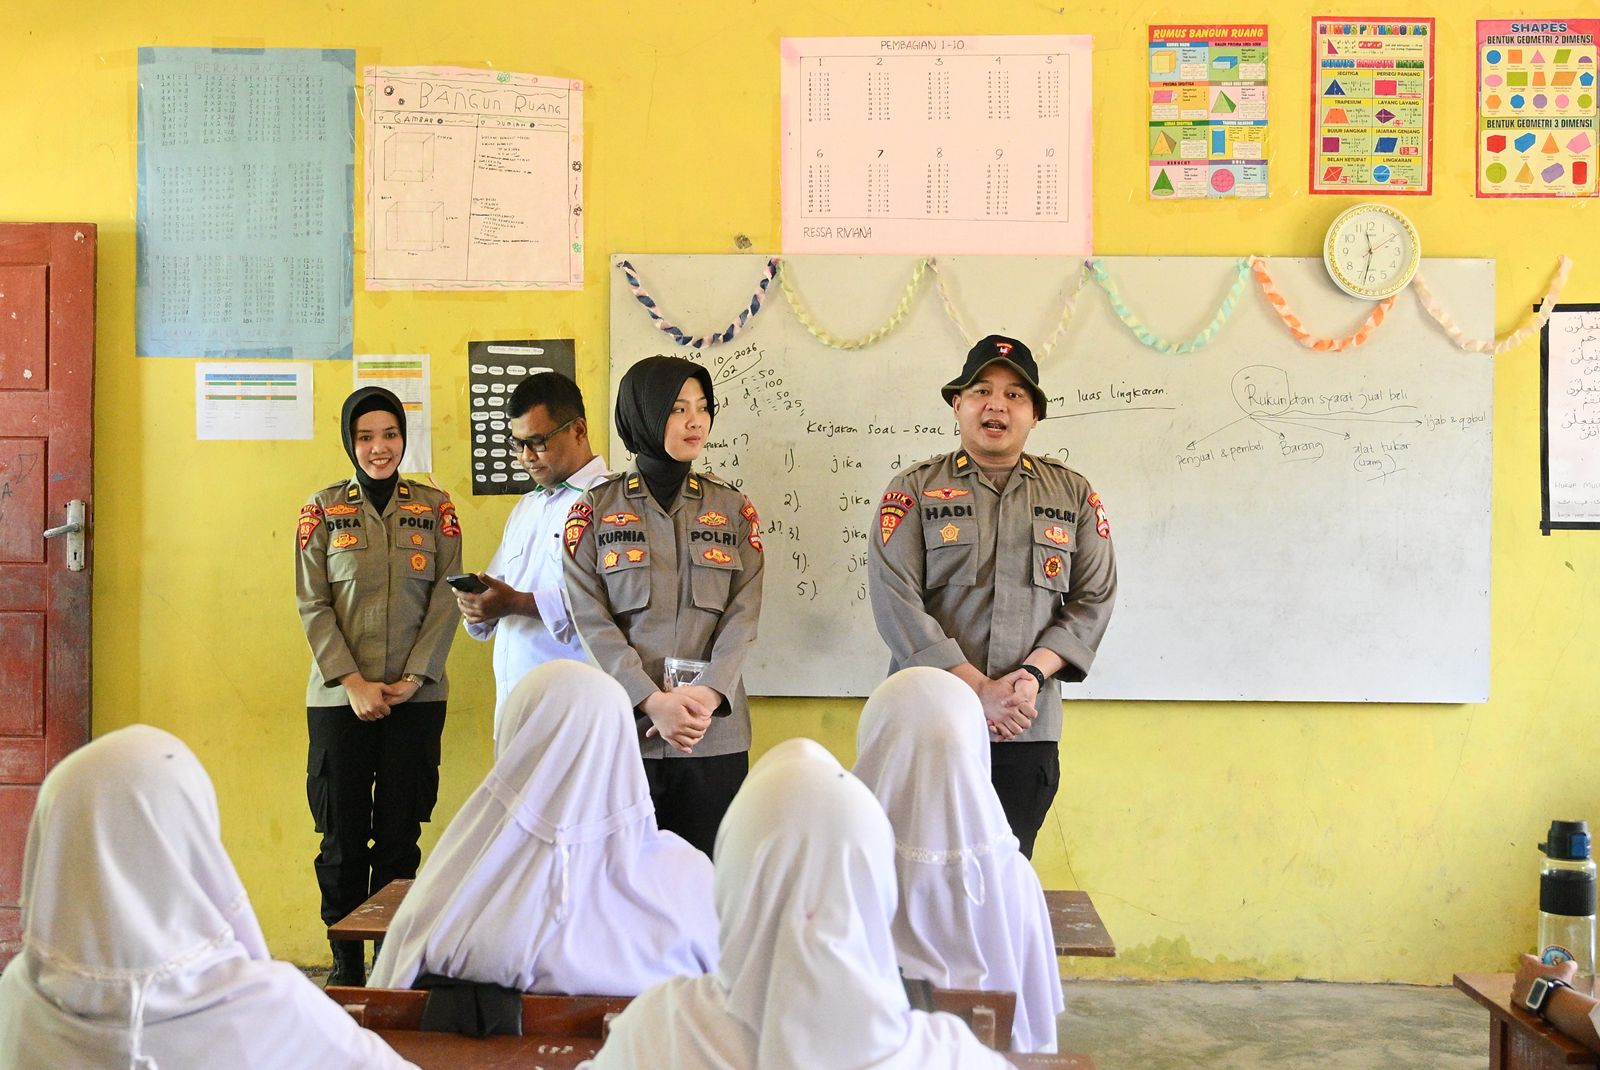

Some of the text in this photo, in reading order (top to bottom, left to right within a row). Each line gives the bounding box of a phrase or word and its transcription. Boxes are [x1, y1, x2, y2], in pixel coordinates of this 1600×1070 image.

[1511, 23, 1568, 33] SHAPES
[1153, 29, 1264, 38] RUMUS BANGUN RUANG
[1487, 35, 1593, 44] BENTUK GEOMETRI 2 DIMENSI
[880, 40, 965, 50] PEMBAGIAN 1-10
[876, 58, 883, 66] 2
[935, 58, 943, 66] 3
[1045, 56, 1054, 64] 5
[1487, 119, 1593, 128] BENTUK GEOMETRI 3 DIMENSI
[816, 149, 824, 158] 6
[877, 149, 884, 158] 7
[936, 148, 943, 158] 8
[996, 148, 1003, 160] 9
[1045, 148, 1055, 158] 10
[1355, 224, 1362, 232] 11
[1366, 222, 1375, 231] 12
[803, 227, 832, 238] RESSA
[1345, 234, 1355, 243] 10
[1343, 248, 1349, 256] 9
[1394, 247, 1401, 256] 3
[1346, 262, 1353, 270] 8
[1390, 260, 1396, 268] 4
[1357, 271, 1363, 279] 7
[1369, 274, 1375, 282] 6
[1381, 271, 1387, 279] 5
[734, 342, 758, 360] 2026
[714, 357, 724, 366] 10
[722, 365, 737, 378] 02
[760, 368, 775, 379] 50
[743, 387, 751, 399] d
[765, 378, 783, 389] 100
[750, 398, 758, 411] d
[776, 391, 790, 399] 50
[1077, 389, 1102, 403] luas
[1244, 384, 1286, 406] Rukun
[1319, 392, 1352, 411] syarat
[1389, 388, 1408, 400] beli
[1280, 441, 1324, 459] Barang
[732, 454, 739, 467] d
[831, 454, 862, 472] jika
[839, 490, 870, 511] jika
[926, 505, 972, 520] HADI
[1035, 506, 1076, 523] POLRI
[327, 517, 361, 532] DEKA
[400, 517, 435, 531] POLRI
[883, 516, 896, 527] 83
[301, 525, 310, 534] 83
[567, 528, 579, 539] 83
[843, 526, 867, 543] jika
[598, 531, 646, 546] KURNIA
[690, 531, 736, 546] POLRI
